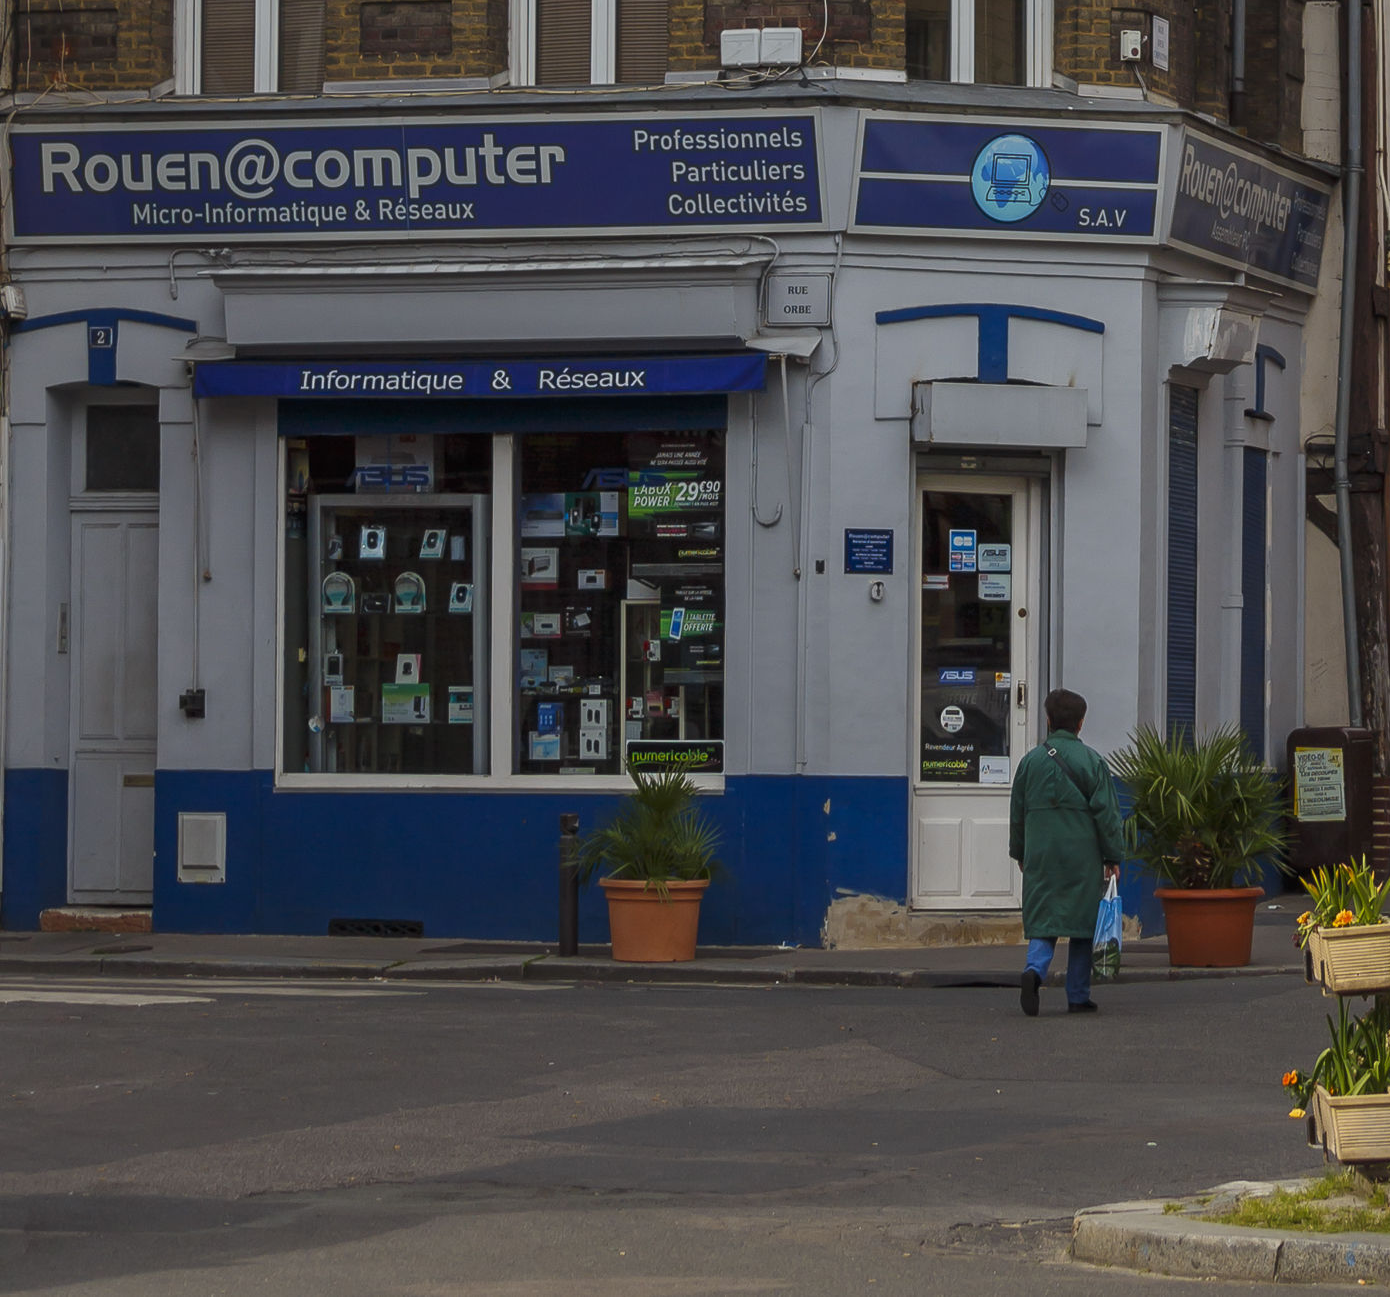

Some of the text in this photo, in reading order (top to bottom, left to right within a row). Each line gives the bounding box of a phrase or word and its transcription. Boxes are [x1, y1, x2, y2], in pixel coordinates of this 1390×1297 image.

[634, 127, 803, 150] Professionnels
[672, 160, 805, 182] Particuliers
[668, 190, 807, 214] Collectivités
[133, 198, 475, 227] Micro-Informatique & Réseaux
[1078, 208, 1126, 227] S.A.V
[787, 286, 808, 295] RUE
[783, 305, 811, 314] ORBE
[97, 330, 105, 344] 2
[300, 367, 645, 394] Informatique & Réseaux
[634, 496, 670, 507] POWER
[953, 536, 973, 546] CB
[683, 623, 714, 631] OFFERTE
[941, 671, 973, 679] ASUS
[925, 743, 974, 753] Revendeur Agréé
[632, 749, 708, 762] numericable
[923, 759, 968, 768] numericable
